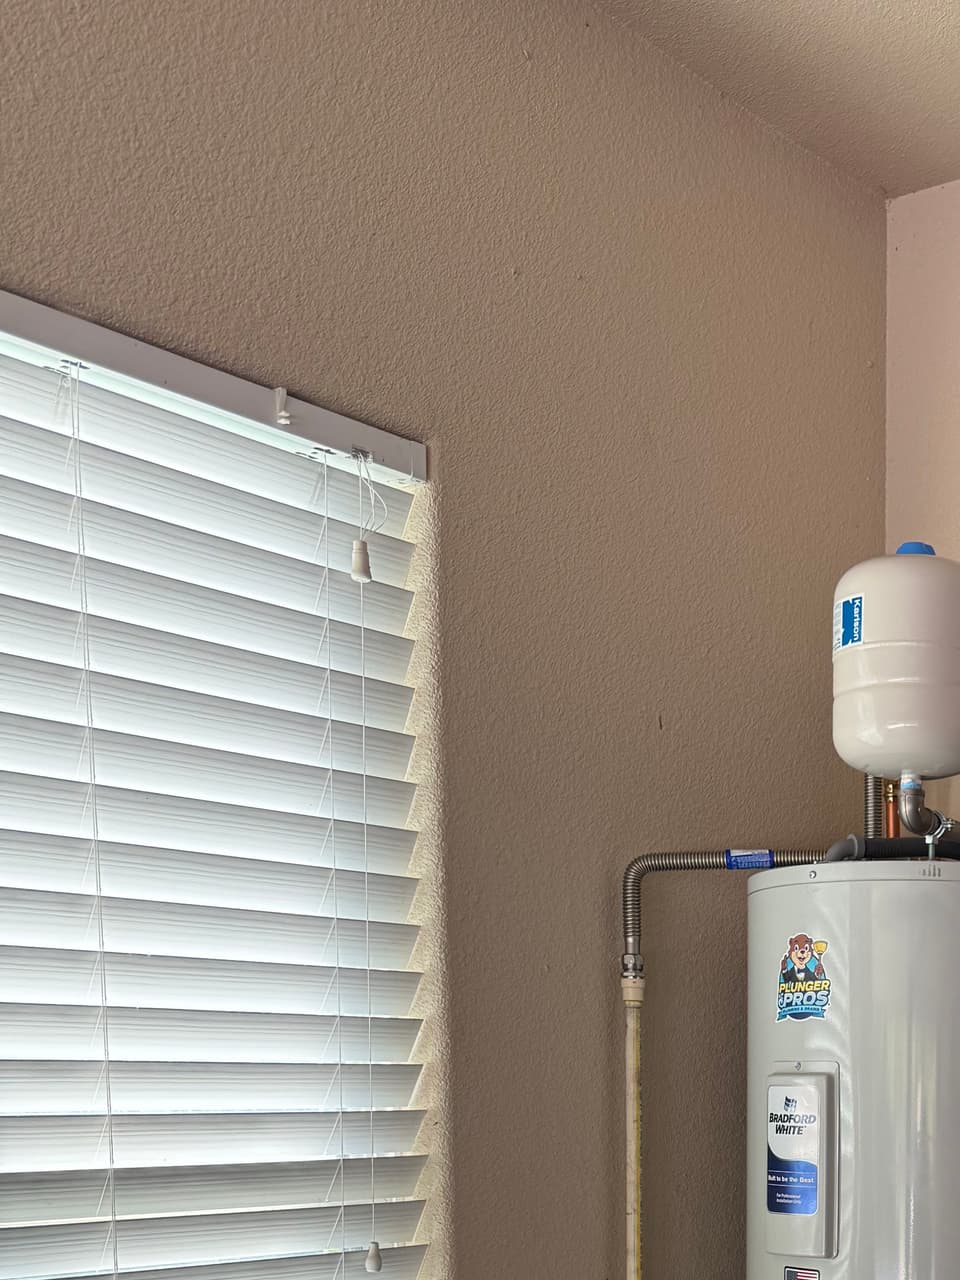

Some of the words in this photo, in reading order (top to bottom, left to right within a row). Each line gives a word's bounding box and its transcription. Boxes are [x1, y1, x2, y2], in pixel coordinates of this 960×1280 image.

[779, 980, 830, 993] PLUNGER
[778, 990, 829, 1007] PROS
[769, 1112, 817, 1124] BRADFORD
[775, 1124, 804, 1135] WHITE
